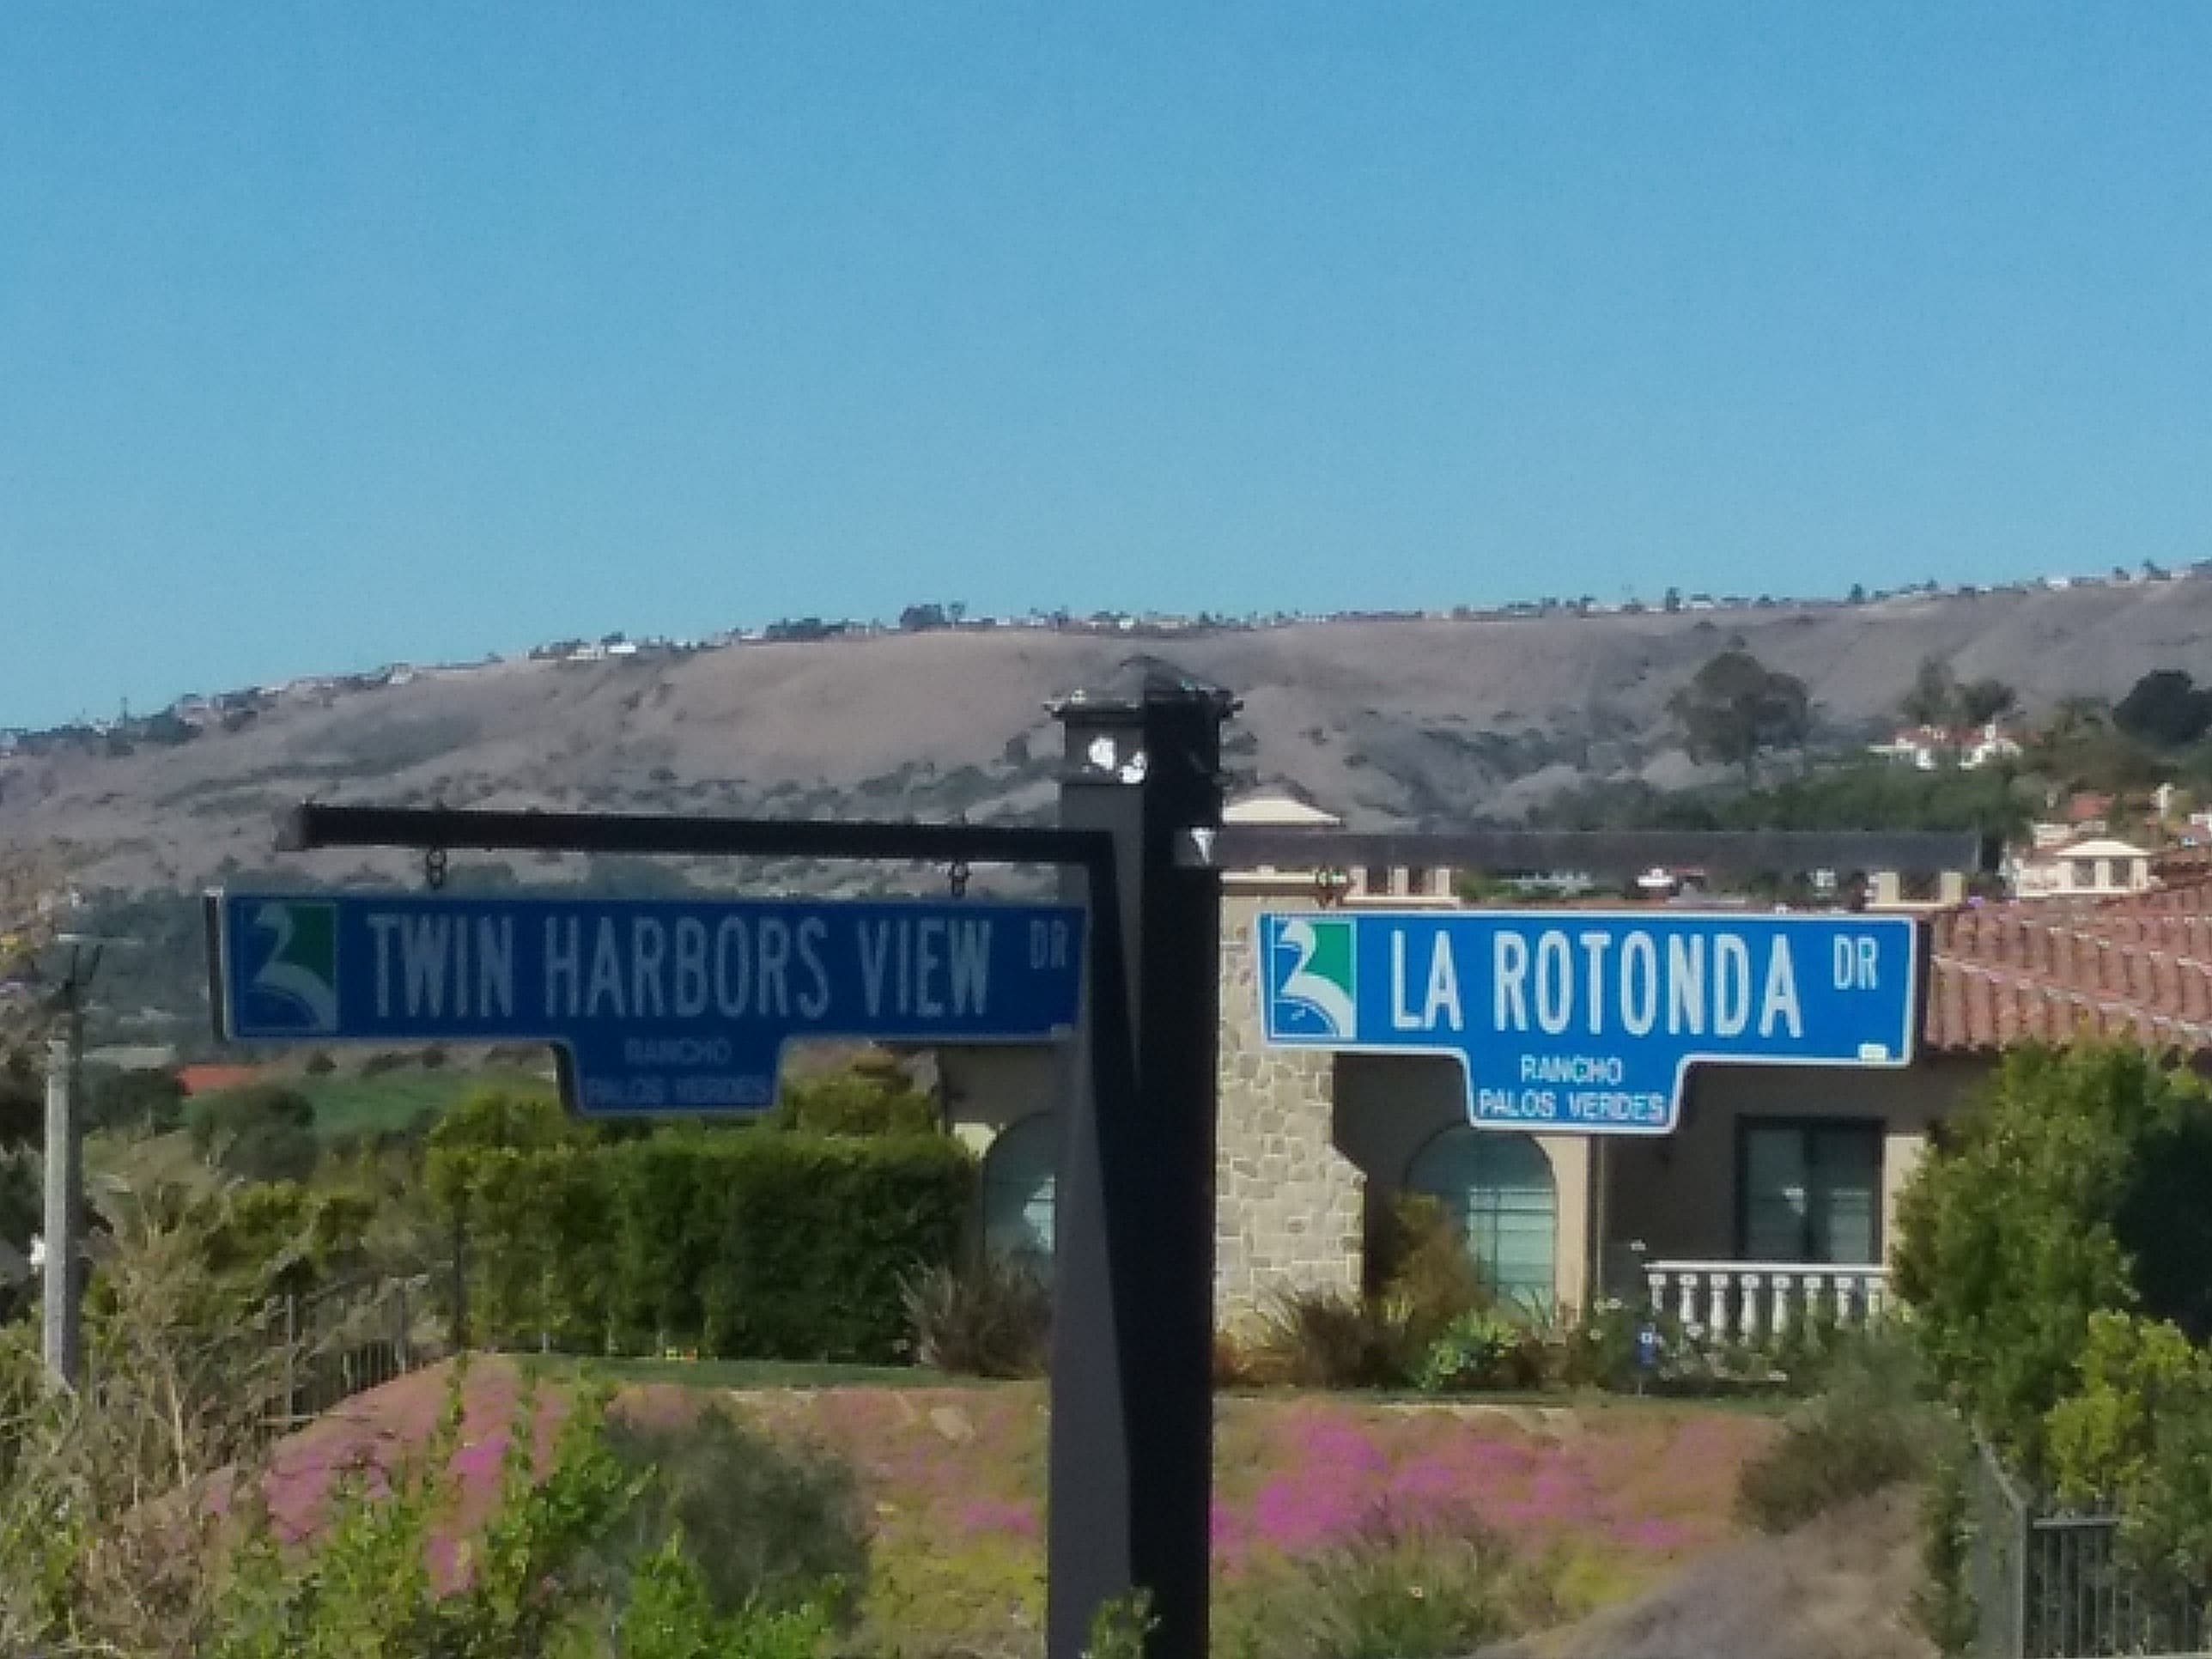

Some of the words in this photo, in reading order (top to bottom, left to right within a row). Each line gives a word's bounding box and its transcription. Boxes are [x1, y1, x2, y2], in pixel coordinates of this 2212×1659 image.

[367, 912, 513, 1018] TWIN
[545, 914, 830, 1018] HARBORS
[860, 918, 993, 1017] VIEW
[1030, 919, 1069, 969] DR
[1391, 929, 1463, 1030] LA
[1493, 929, 1804, 1039] ROTONDA
[1833, 933, 1878, 990] DR
[1521, 1054, 1623, 1085] RANCHO
[1478, 1088, 1556, 1117] PALOS
[1569, 1091, 1664, 1121] VERDES
